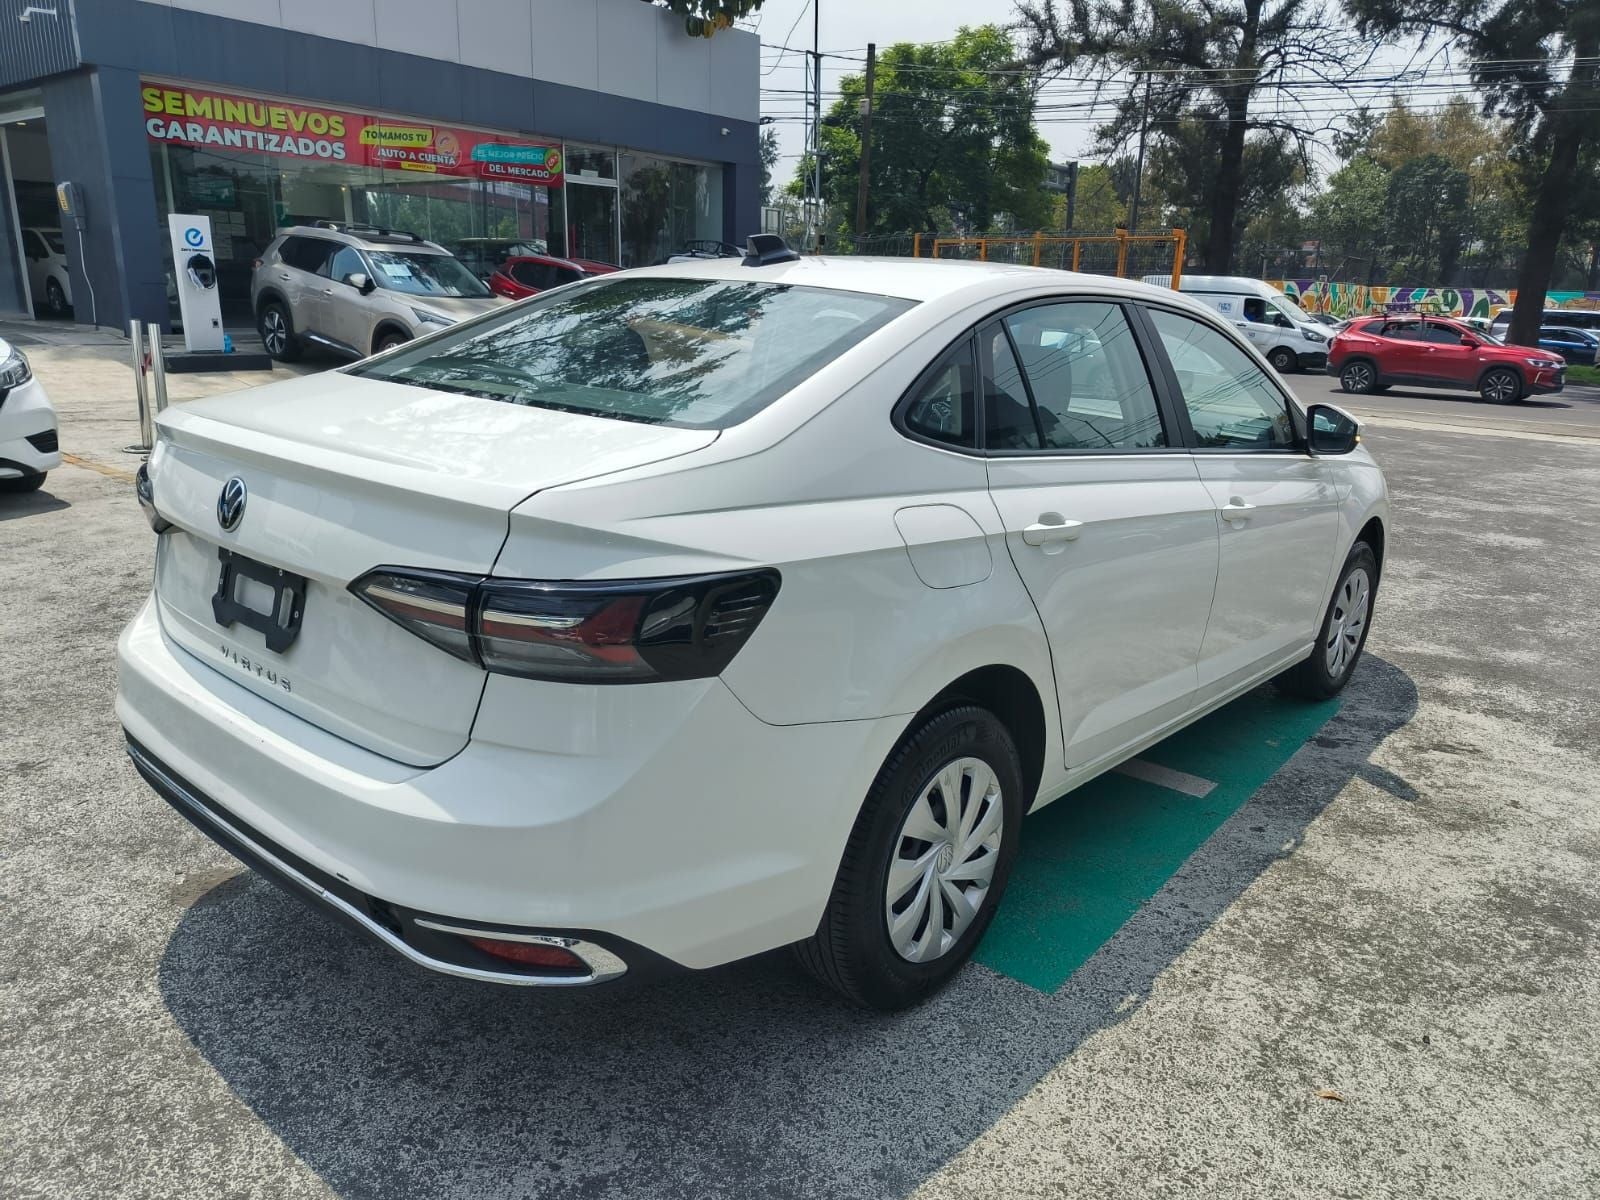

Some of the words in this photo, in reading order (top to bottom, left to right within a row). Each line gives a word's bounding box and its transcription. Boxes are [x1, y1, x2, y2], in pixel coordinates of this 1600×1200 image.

[142, 87, 346, 137] SEMINUEVOS
[145, 117, 346, 160] GARANTIZADOS
[365, 130, 413, 141] TOMAMOS
[416, 133, 428, 142] TU
[378, 148, 407, 158] AUTO
[409, 152, 416, 160] A
[419, 153, 456, 165] CUENTA
[478, 149, 487, 157] EL
[488, 151, 515, 159] MEJOR
[516, 152, 544, 161] PRECIO
[489, 164, 506, 173] DEL
[508, 167, 549, 178] MERCADO
[220, 645, 292, 692] VIRTUS
